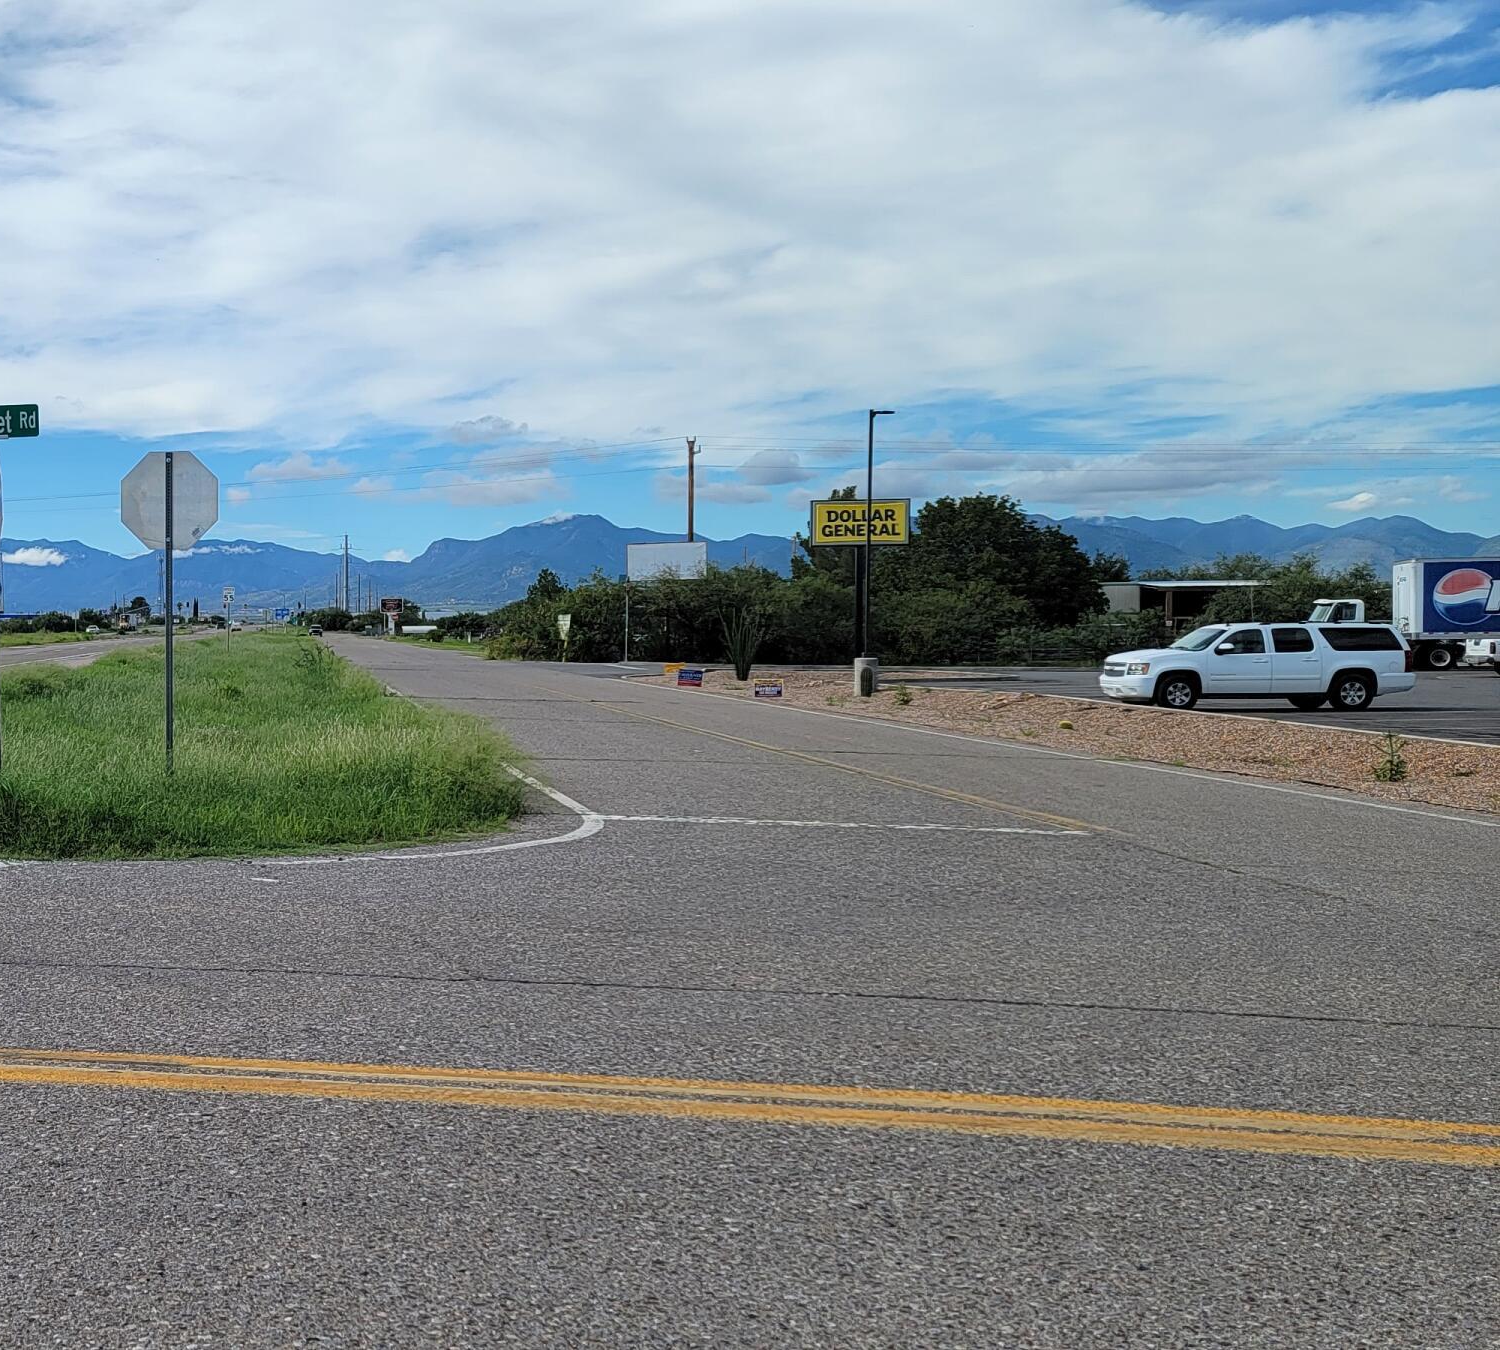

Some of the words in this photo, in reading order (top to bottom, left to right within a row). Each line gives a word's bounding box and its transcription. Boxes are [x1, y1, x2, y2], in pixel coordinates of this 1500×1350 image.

[20, 411, 36, 429] Rd
[826, 509, 896, 522] DOLLAR
[822, 524, 901, 537] GENERAL
